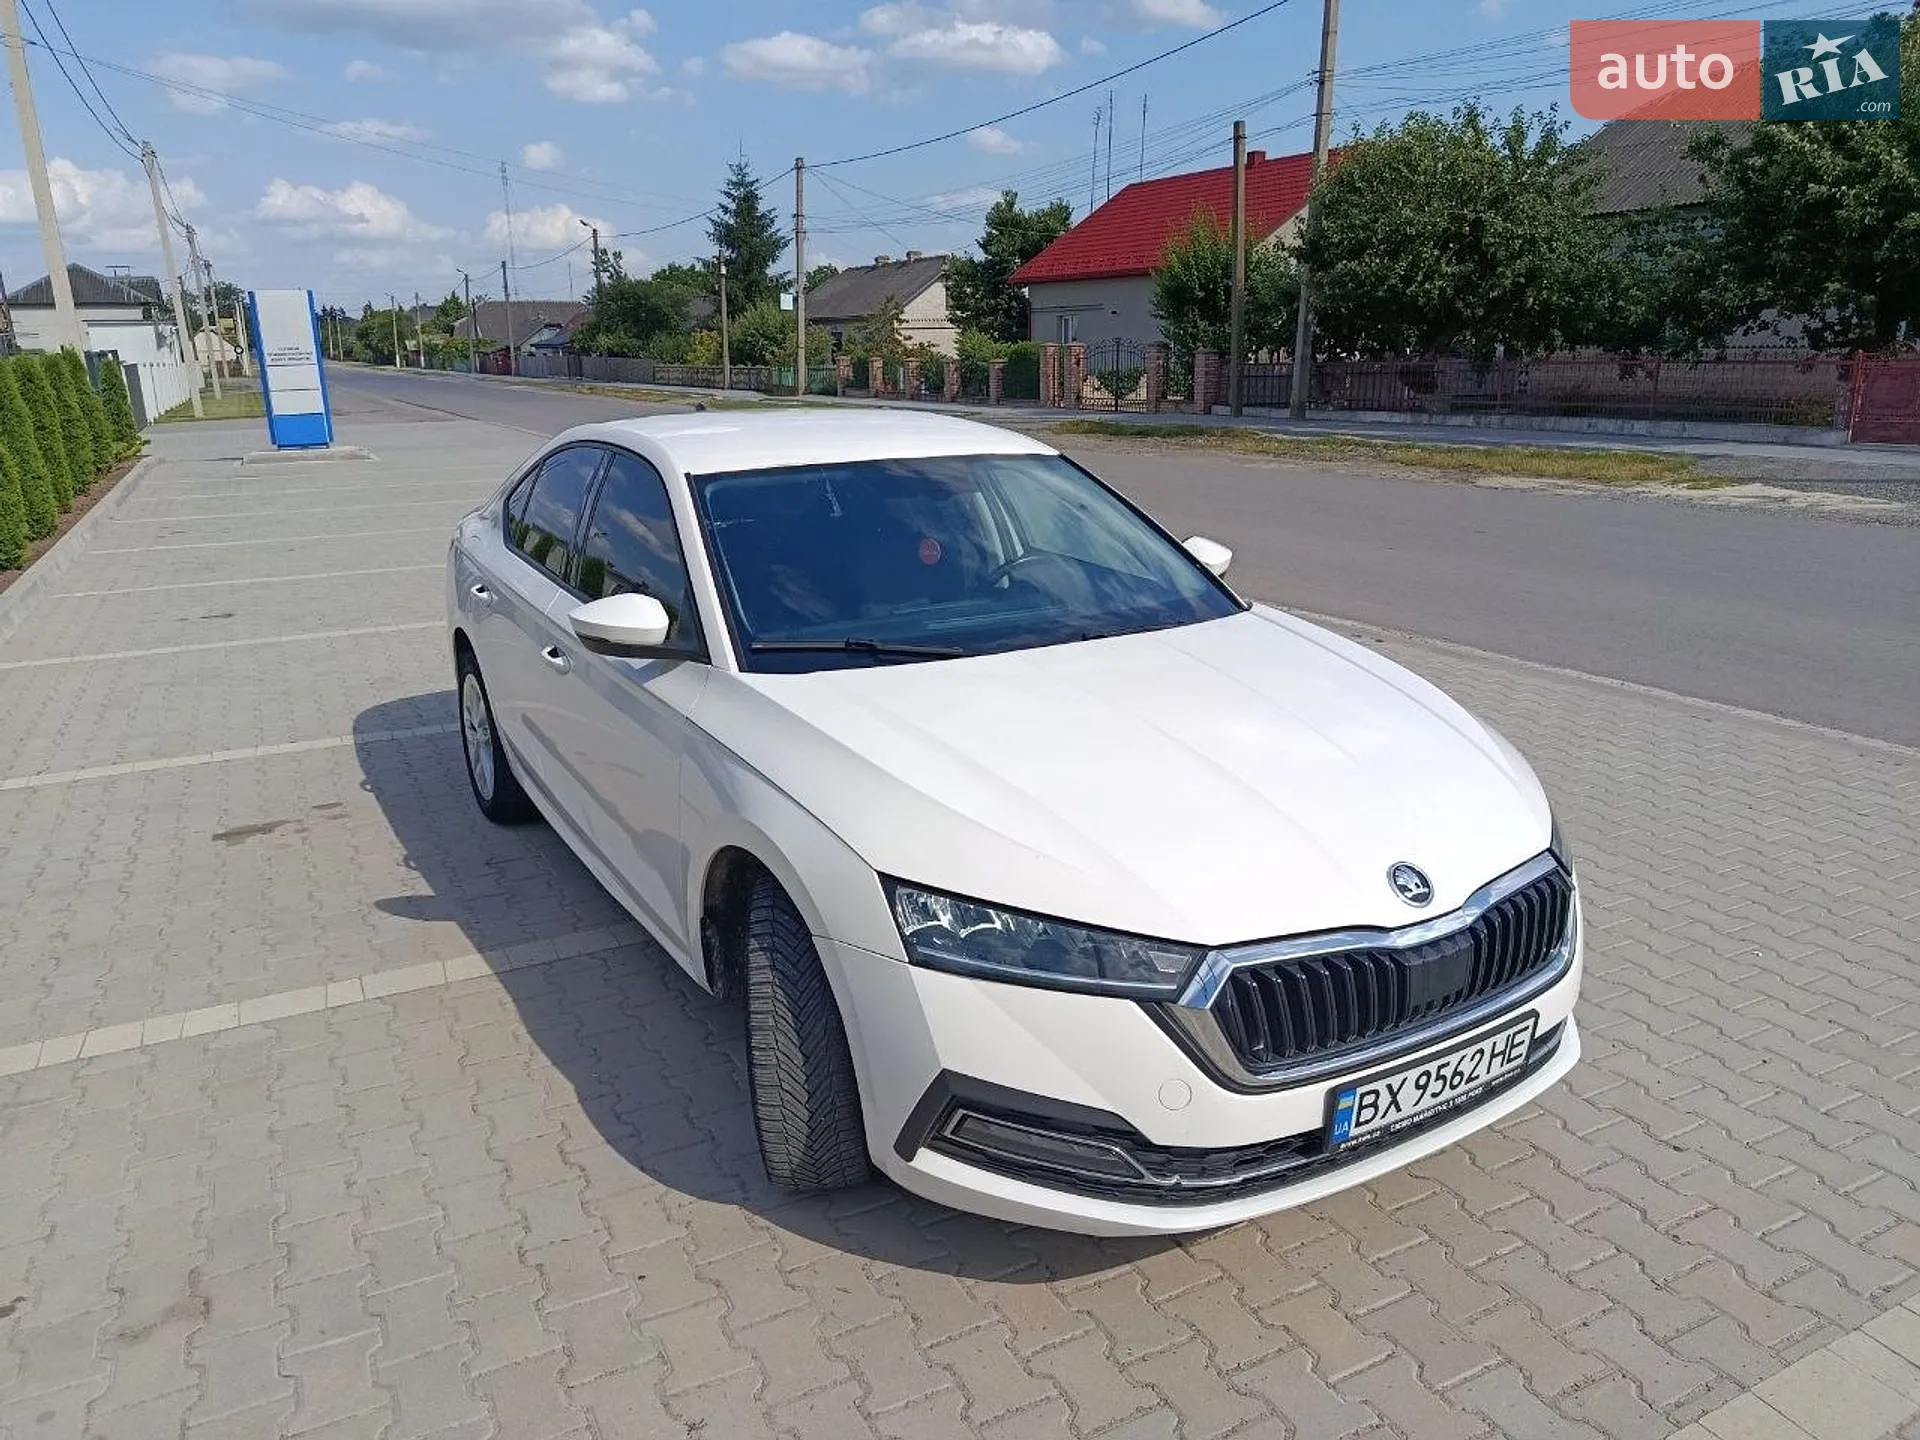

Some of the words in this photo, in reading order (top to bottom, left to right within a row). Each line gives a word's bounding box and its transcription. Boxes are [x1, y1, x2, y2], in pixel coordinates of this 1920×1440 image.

[1354, 1076, 1408, 1128] BX
[1413, 1047, 1485, 1107] 9562
[1486, 1025, 1530, 1075] HE
[1334, 1120, 1349, 1135] UA
